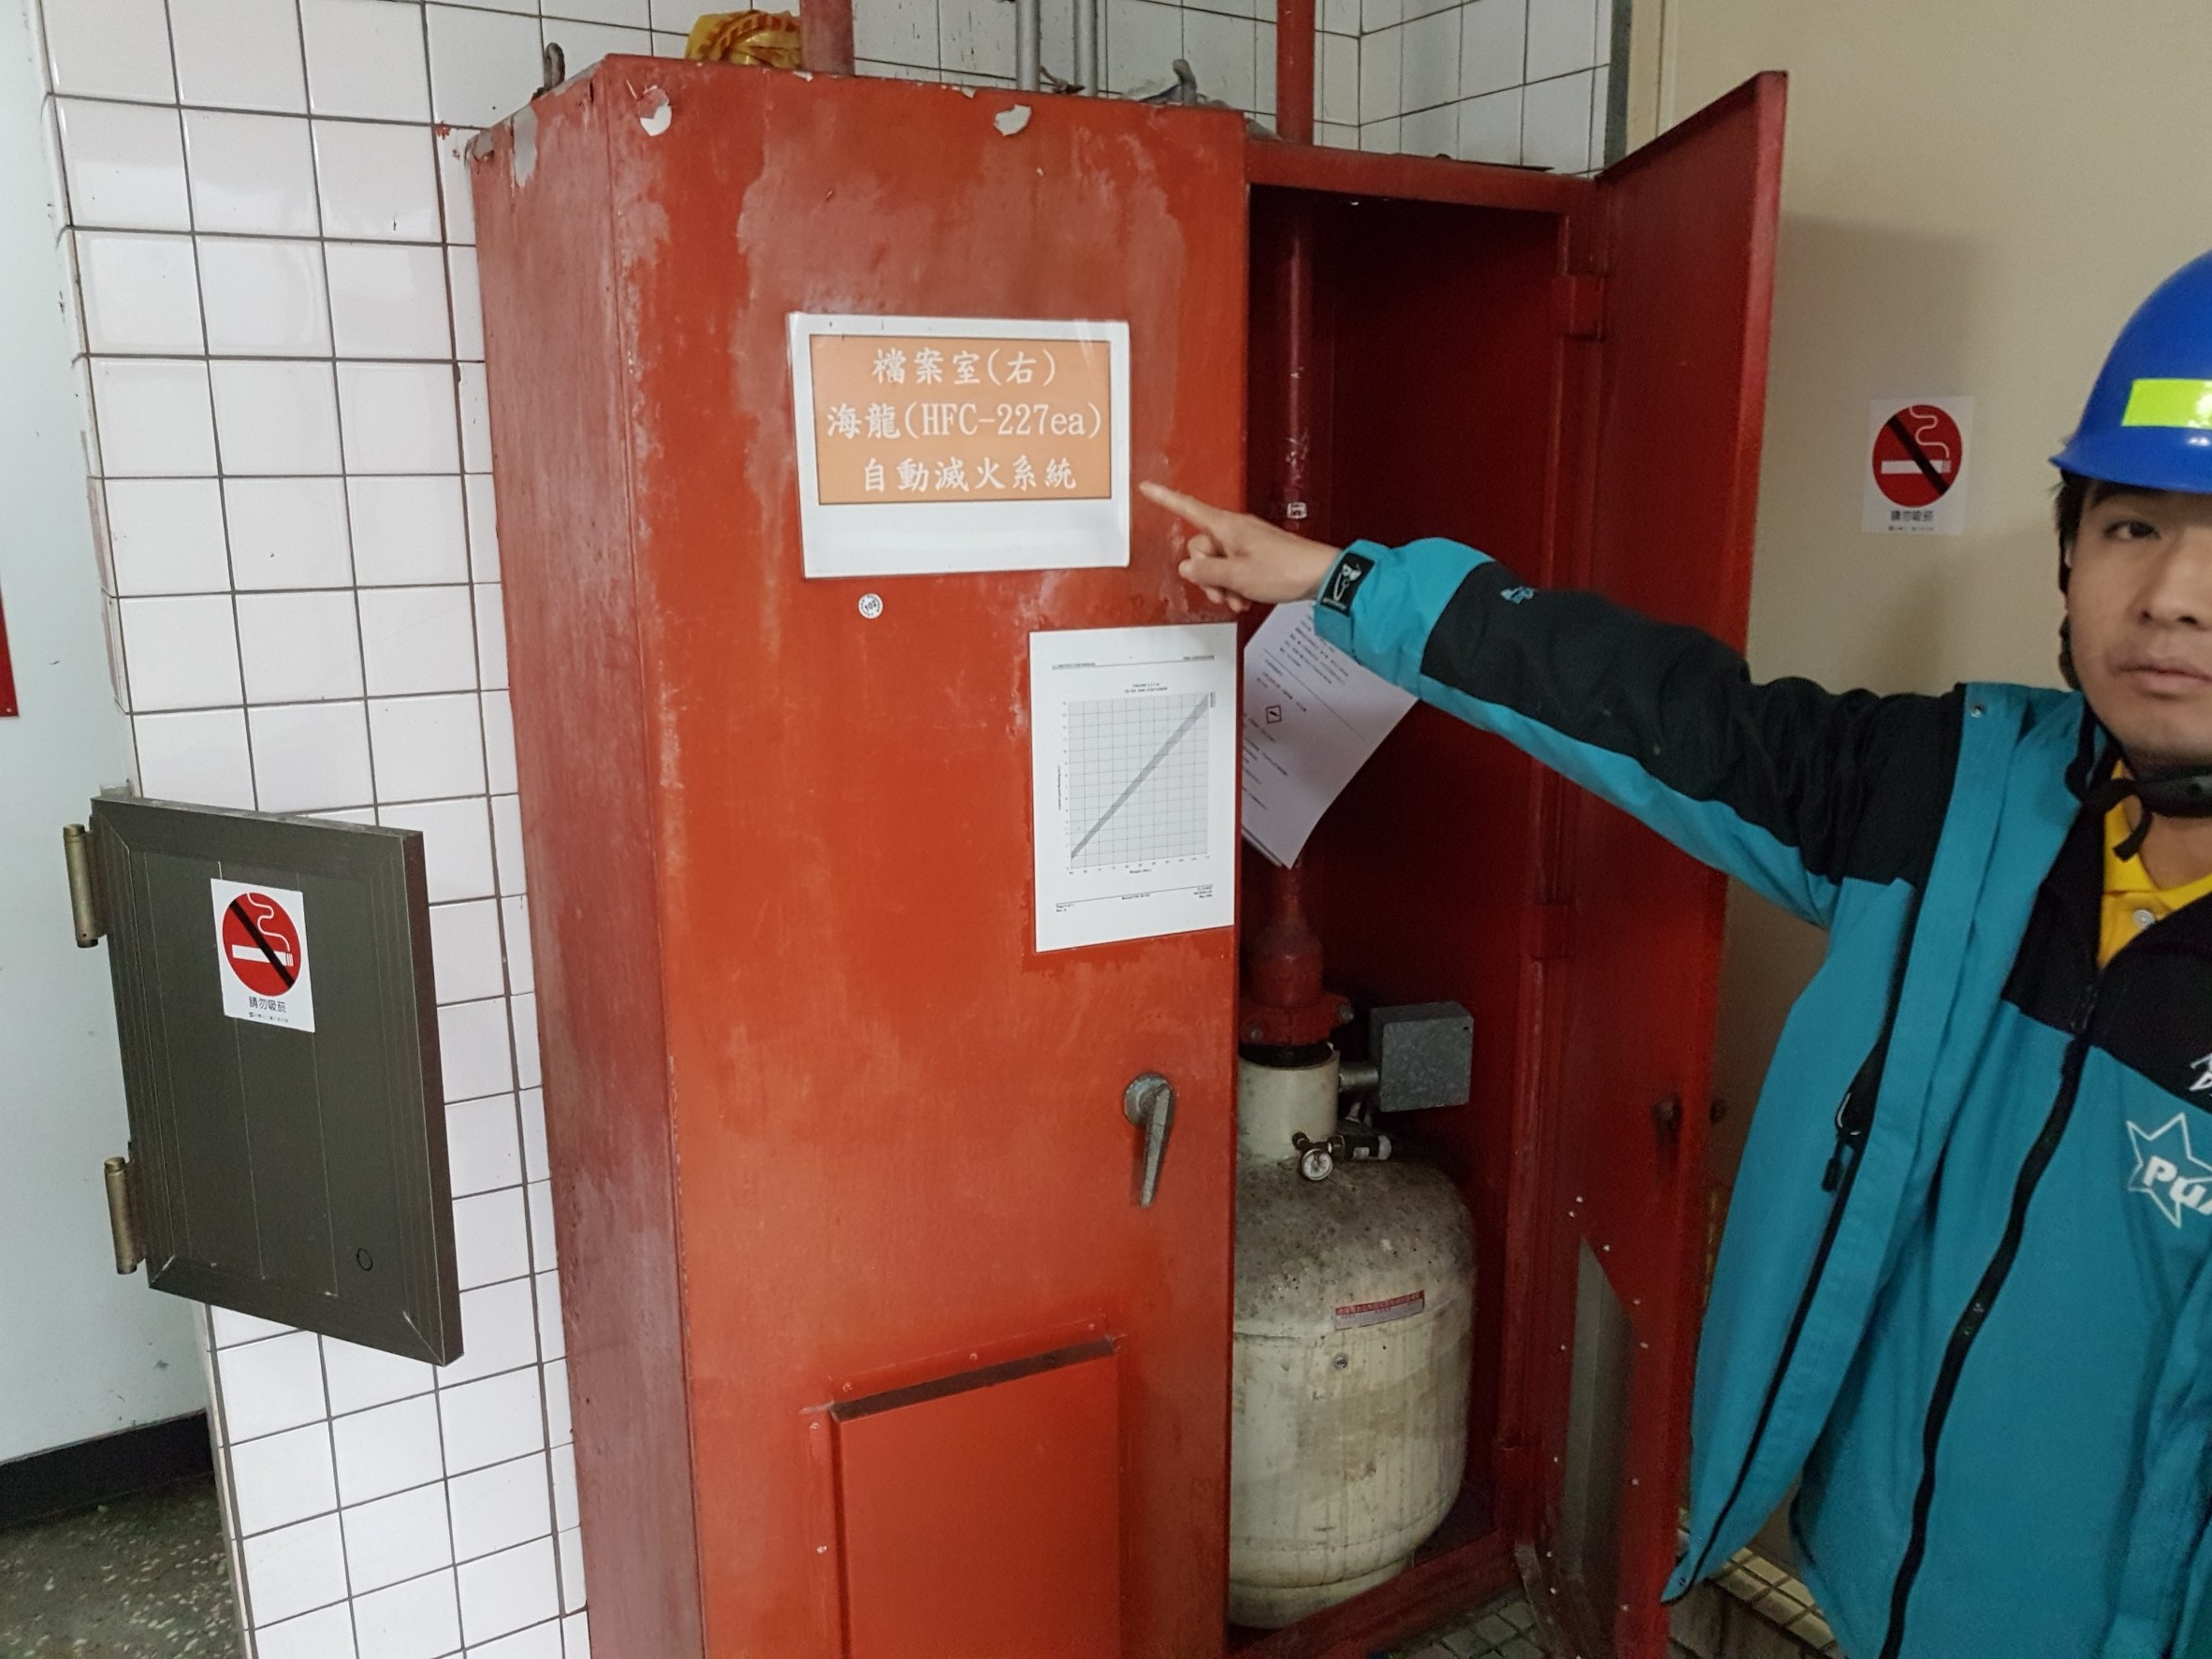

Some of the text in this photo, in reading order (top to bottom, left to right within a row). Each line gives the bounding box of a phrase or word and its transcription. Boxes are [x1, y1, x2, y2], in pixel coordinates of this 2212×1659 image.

[872, 347, 1055, 386] 檔案室(右)
[826, 401, 1101, 440] 海龍(HFC-227ea)
[863, 455, 1077, 493] 自動滅火系統
